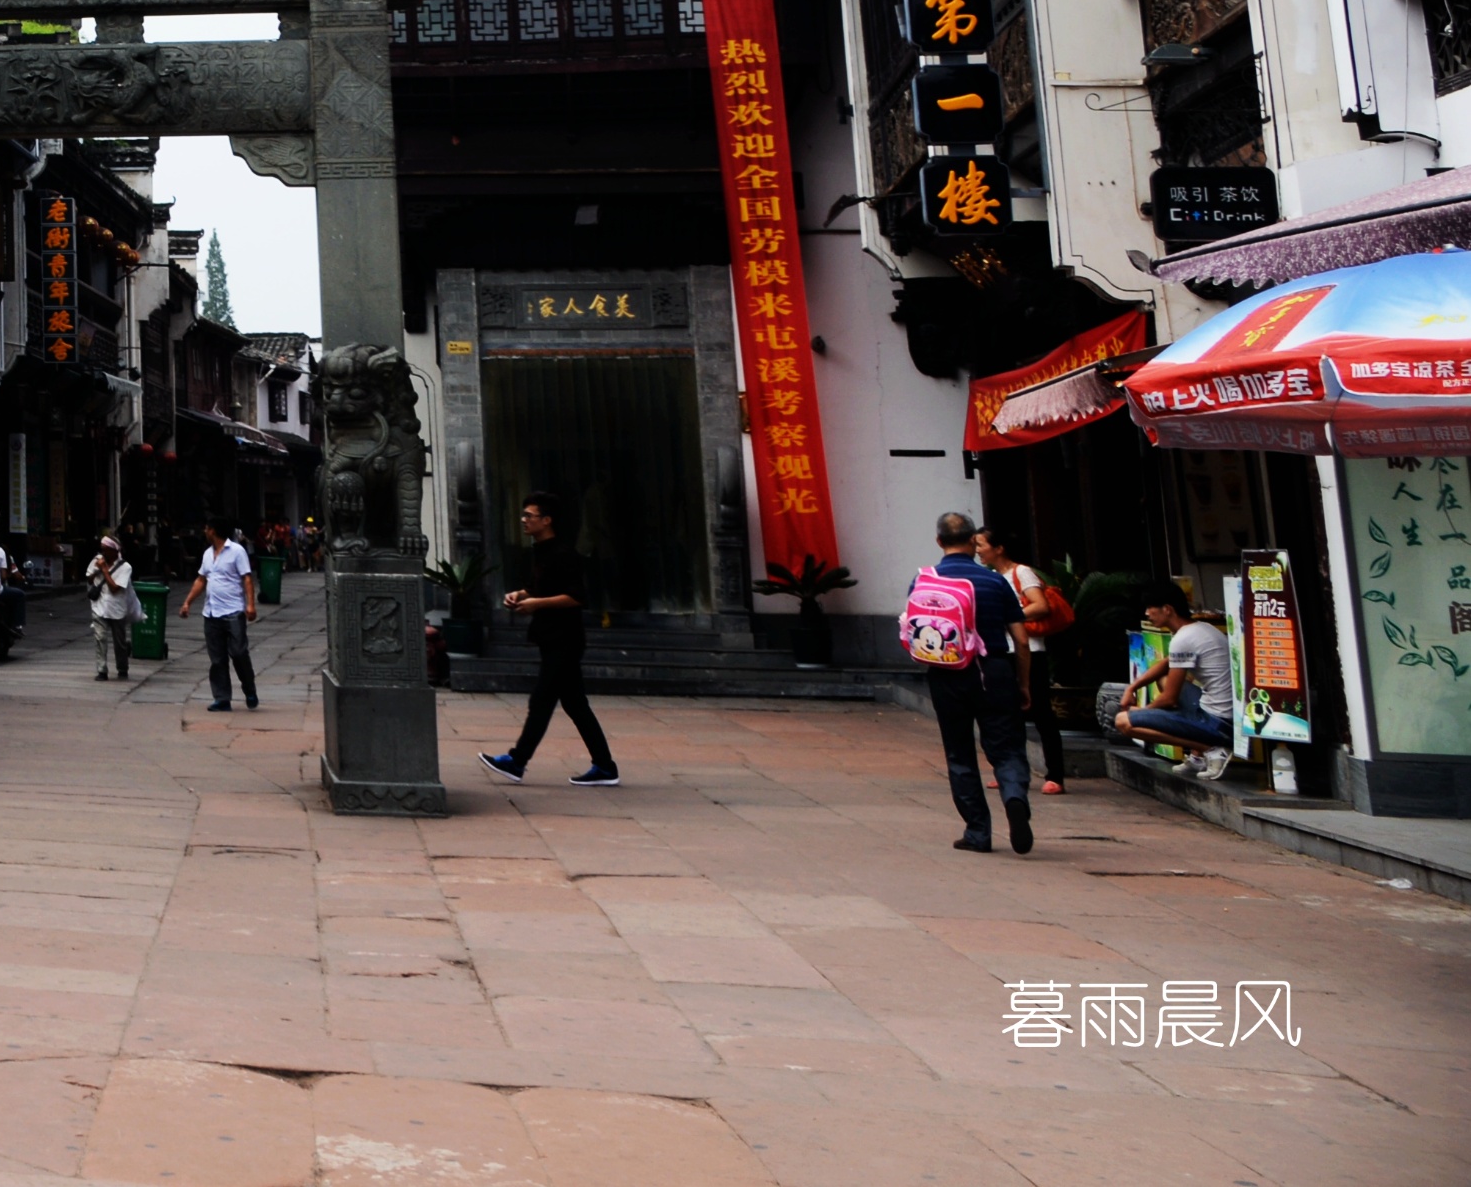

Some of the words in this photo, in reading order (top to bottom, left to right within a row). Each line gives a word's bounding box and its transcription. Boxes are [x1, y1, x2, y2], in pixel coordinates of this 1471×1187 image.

[1170, 186, 1208, 202] 吸引
[1219, 186, 1260, 202] 茶饮
[720, 39, 819, 516] 热烈欢迎全国劳模来屯溪考察观光
[539, 293, 635, 319] 美食人家
[1350, 360, 1455, 379] 加多宝凉茶
[1141, 368, 1313, 412] 怕上火喝加多宝
